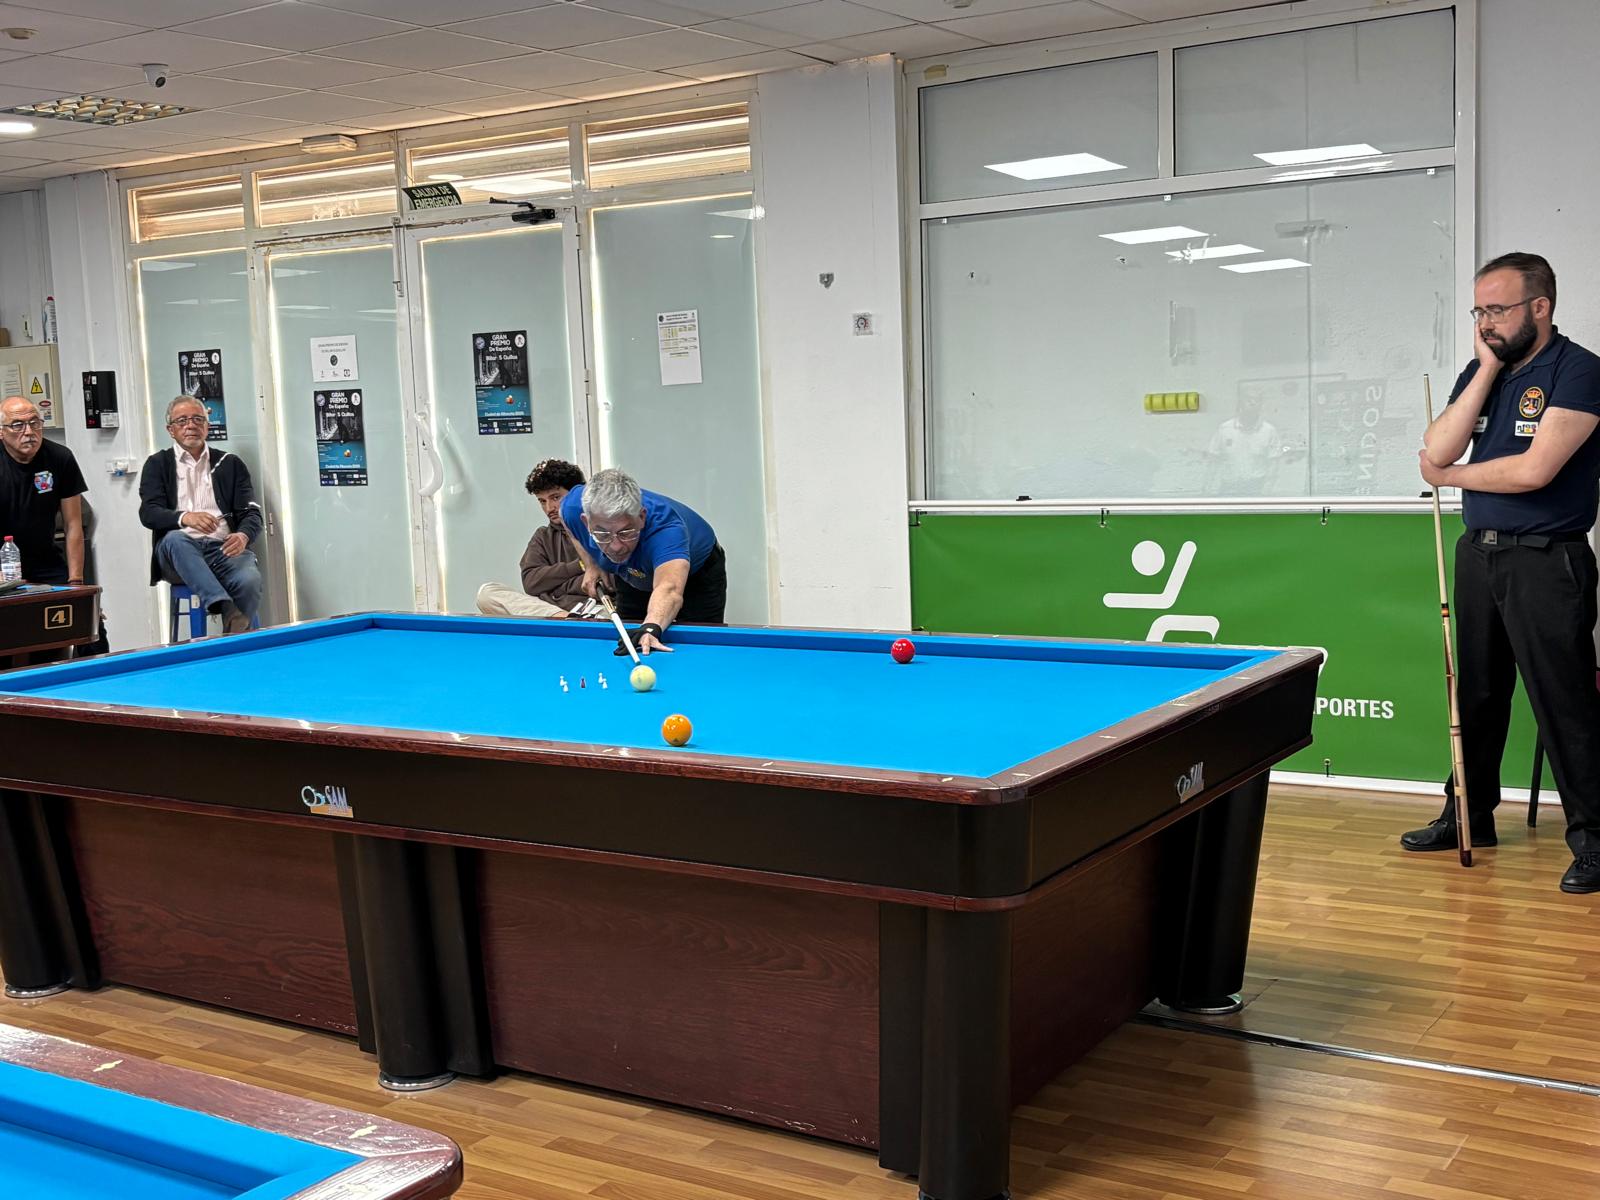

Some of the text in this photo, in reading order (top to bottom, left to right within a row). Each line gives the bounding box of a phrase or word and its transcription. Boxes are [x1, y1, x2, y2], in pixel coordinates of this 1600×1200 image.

[412, 185, 452, 198] SALIDA DE
[414, 195, 459, 209] EMERGENCIA
[51, 610, 66, 624] 4
[1313, 697, 1394, 719] PORTES
